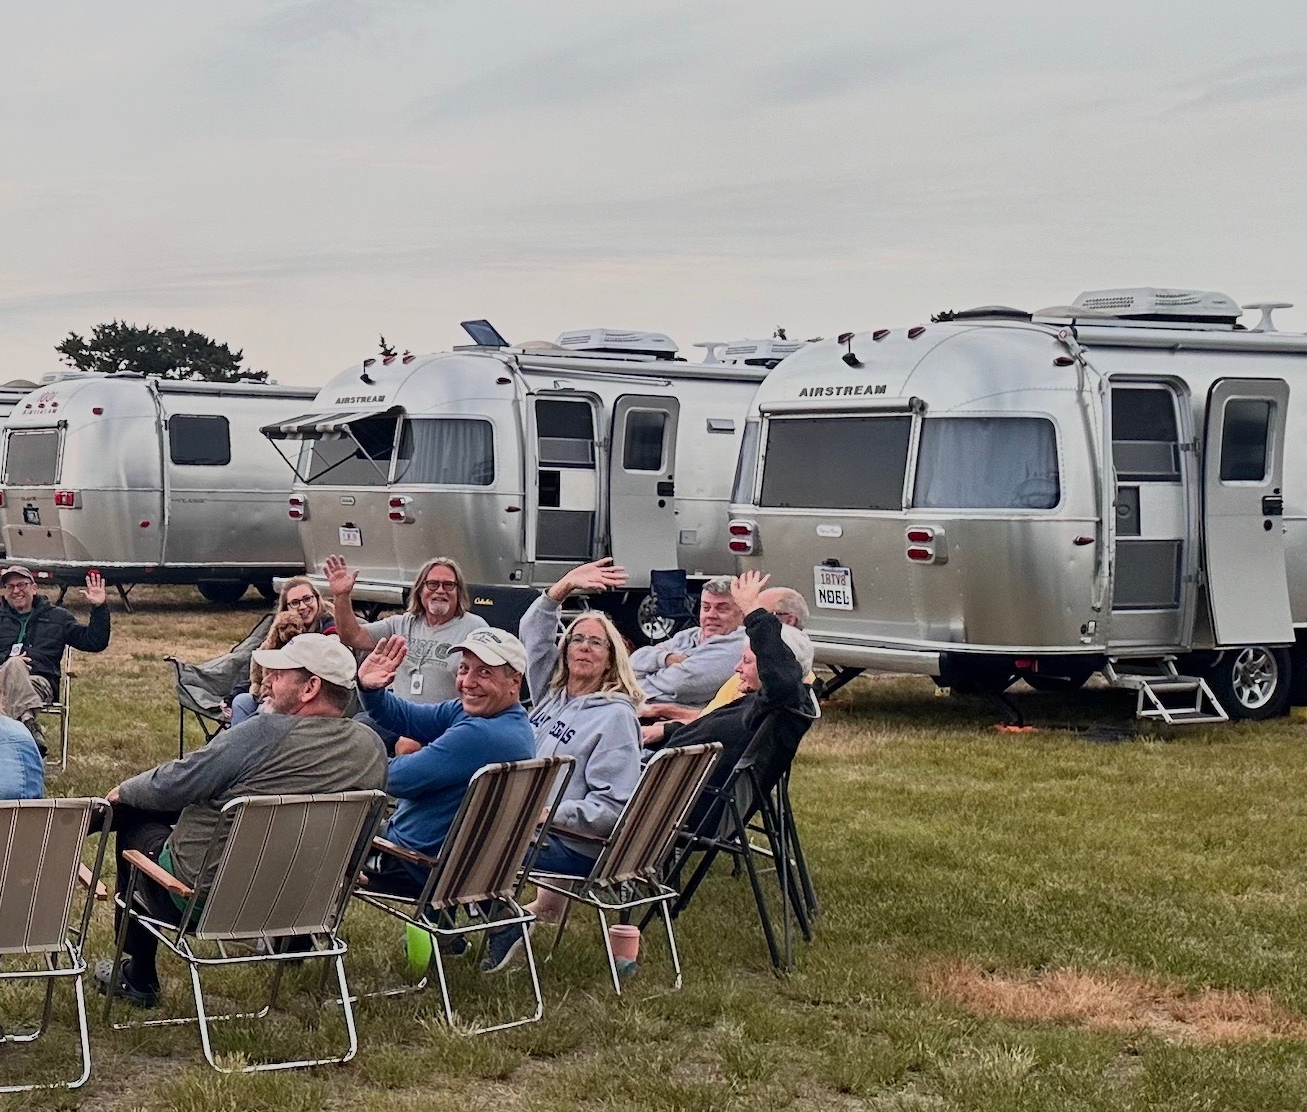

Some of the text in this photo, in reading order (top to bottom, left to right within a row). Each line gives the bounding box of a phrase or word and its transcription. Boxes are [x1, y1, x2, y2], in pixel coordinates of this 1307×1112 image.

[798, 384, 887, 397] AIRSTREAM
[335, 394, 386, 405] AIRSTREAM
[818, 589, 850, 605] NOEL
